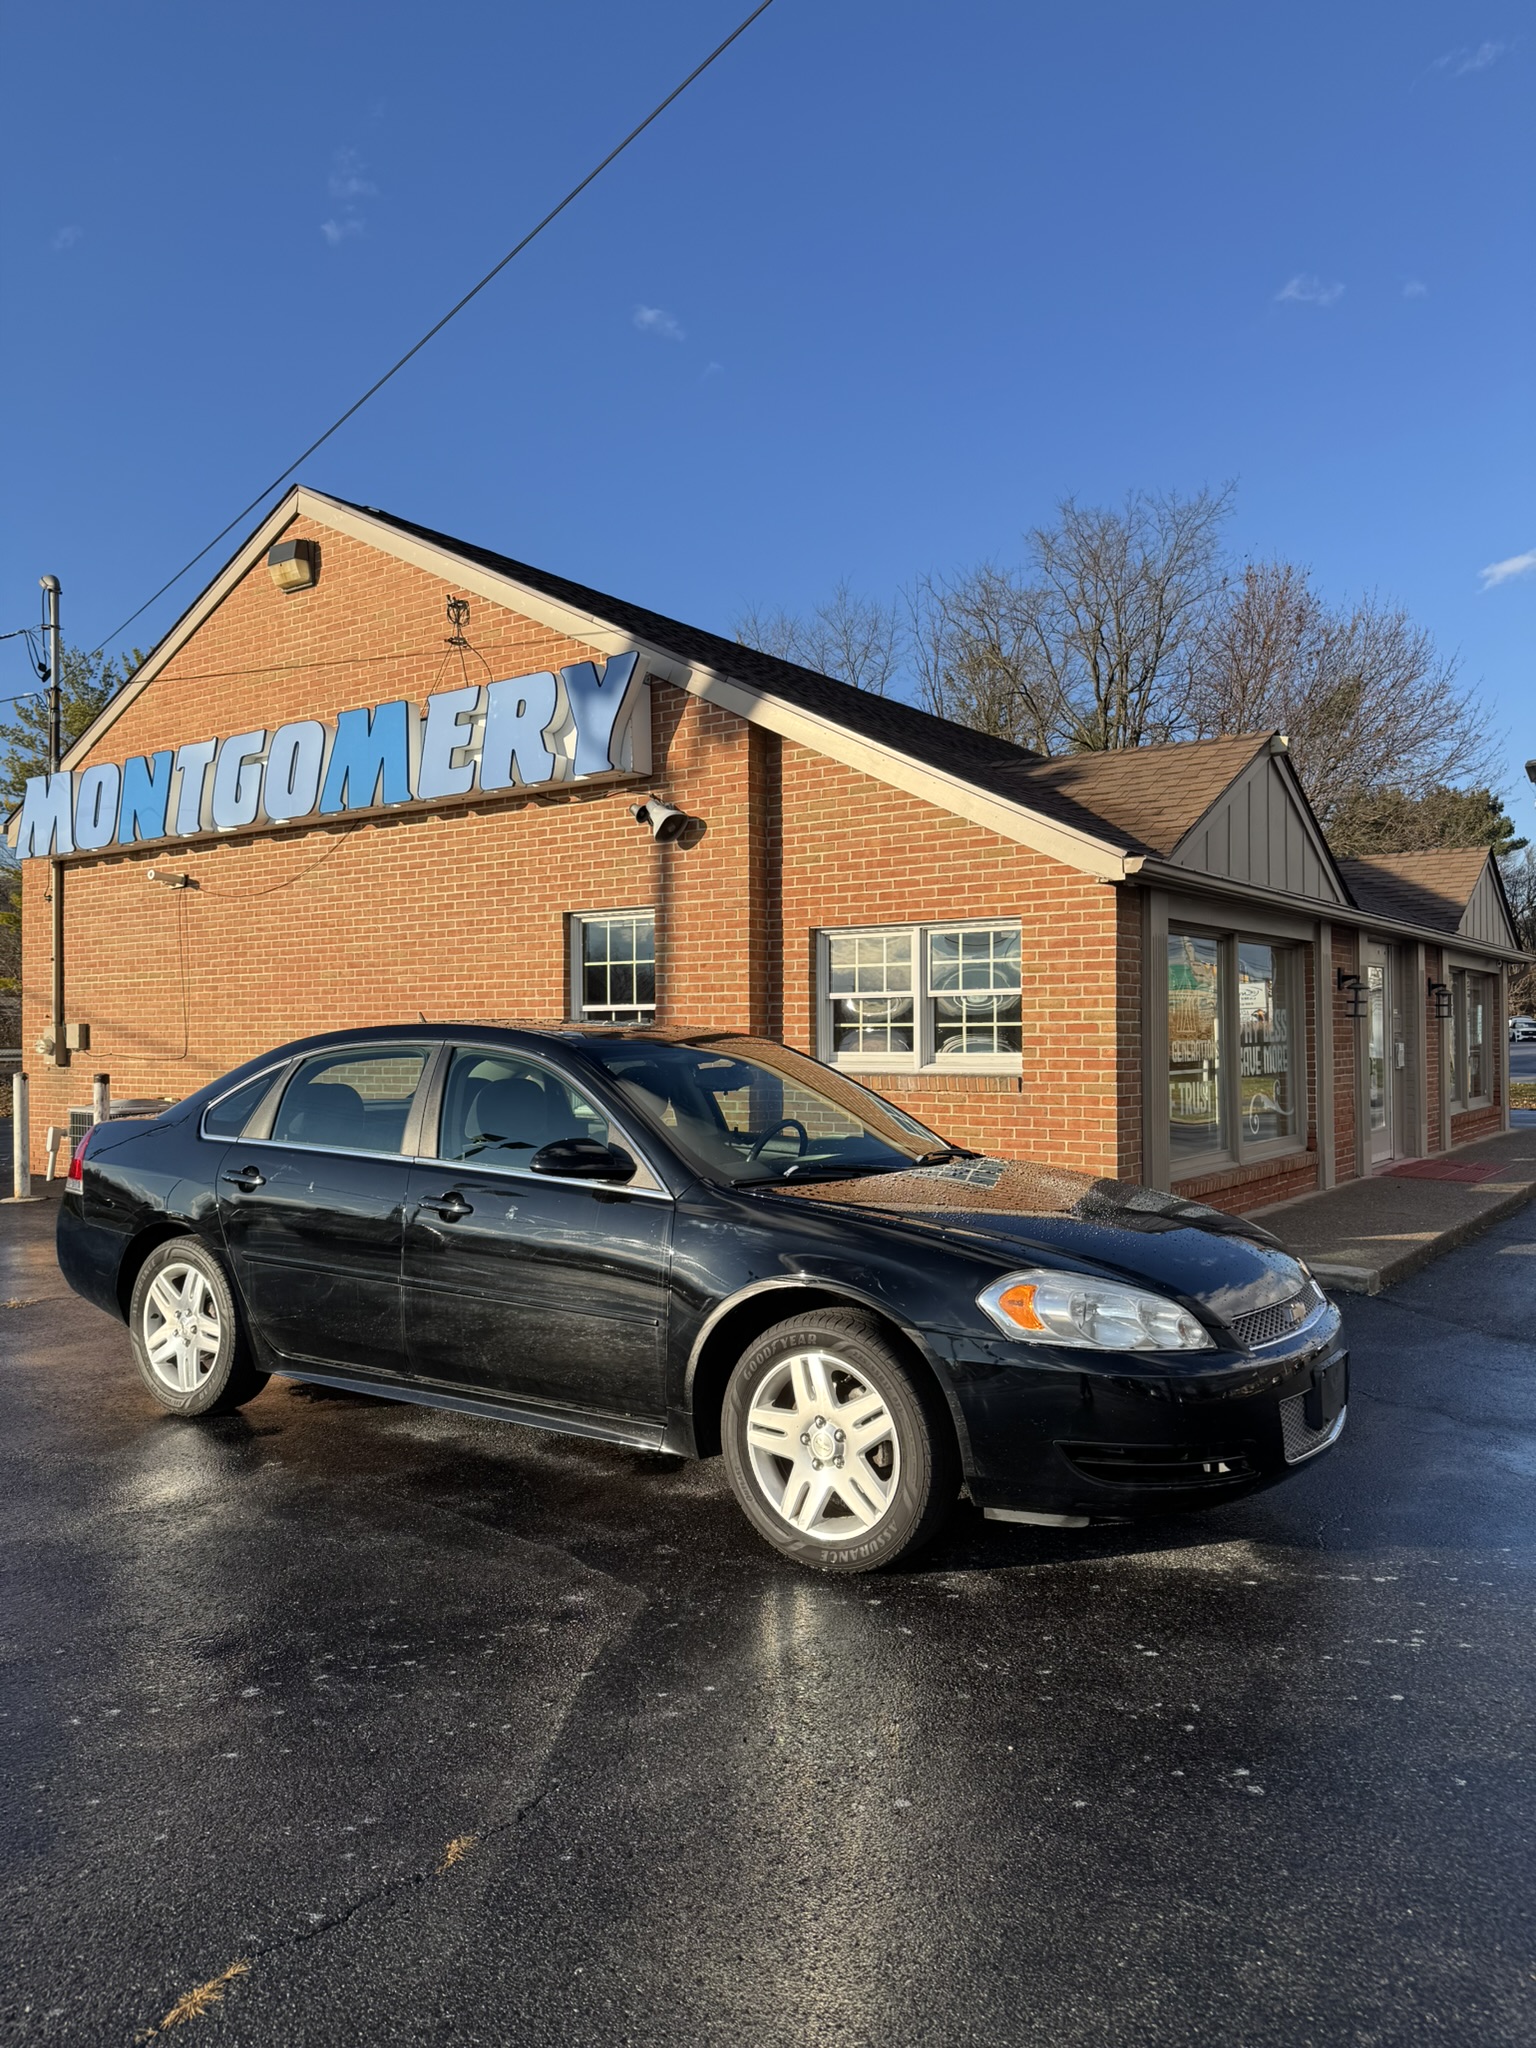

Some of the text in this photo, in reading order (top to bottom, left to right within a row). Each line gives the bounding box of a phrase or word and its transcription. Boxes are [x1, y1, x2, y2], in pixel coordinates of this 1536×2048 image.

[15, 651, 640, 860] MONTGOMERY
[1263, 1044, 1289, 1074] MORE
[1178, 1080, 1213, 1116] TRUST
[743, 1333, 818, 1380] GOODYEAR
[820, 1519, 898, 1563] ASSURANCE
